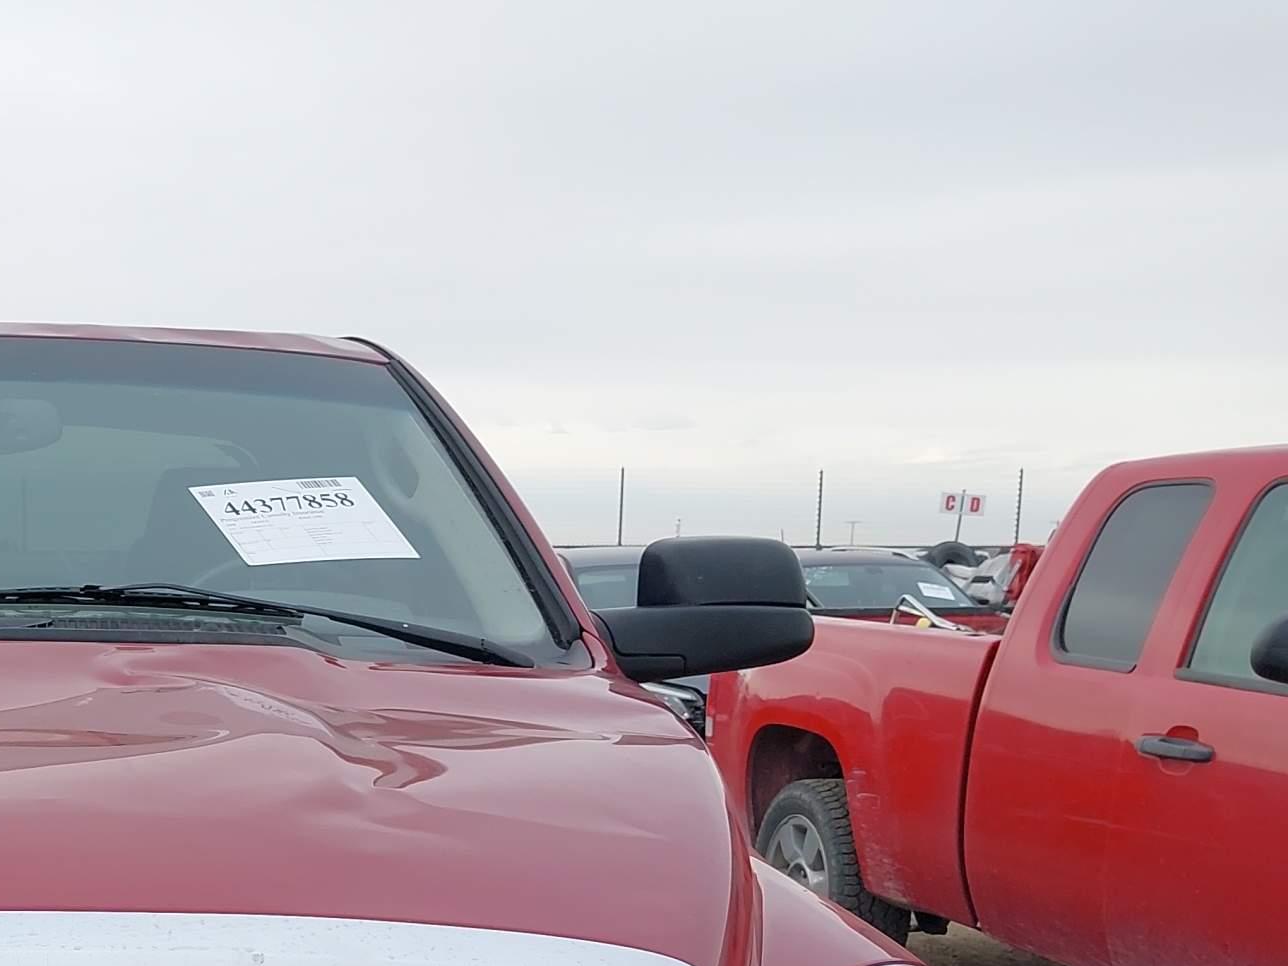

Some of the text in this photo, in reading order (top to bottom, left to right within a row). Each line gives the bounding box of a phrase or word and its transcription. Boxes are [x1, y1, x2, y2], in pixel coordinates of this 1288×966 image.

[223, 492, 355, 516] 44377858
[945, 495, 981, 513] C D
